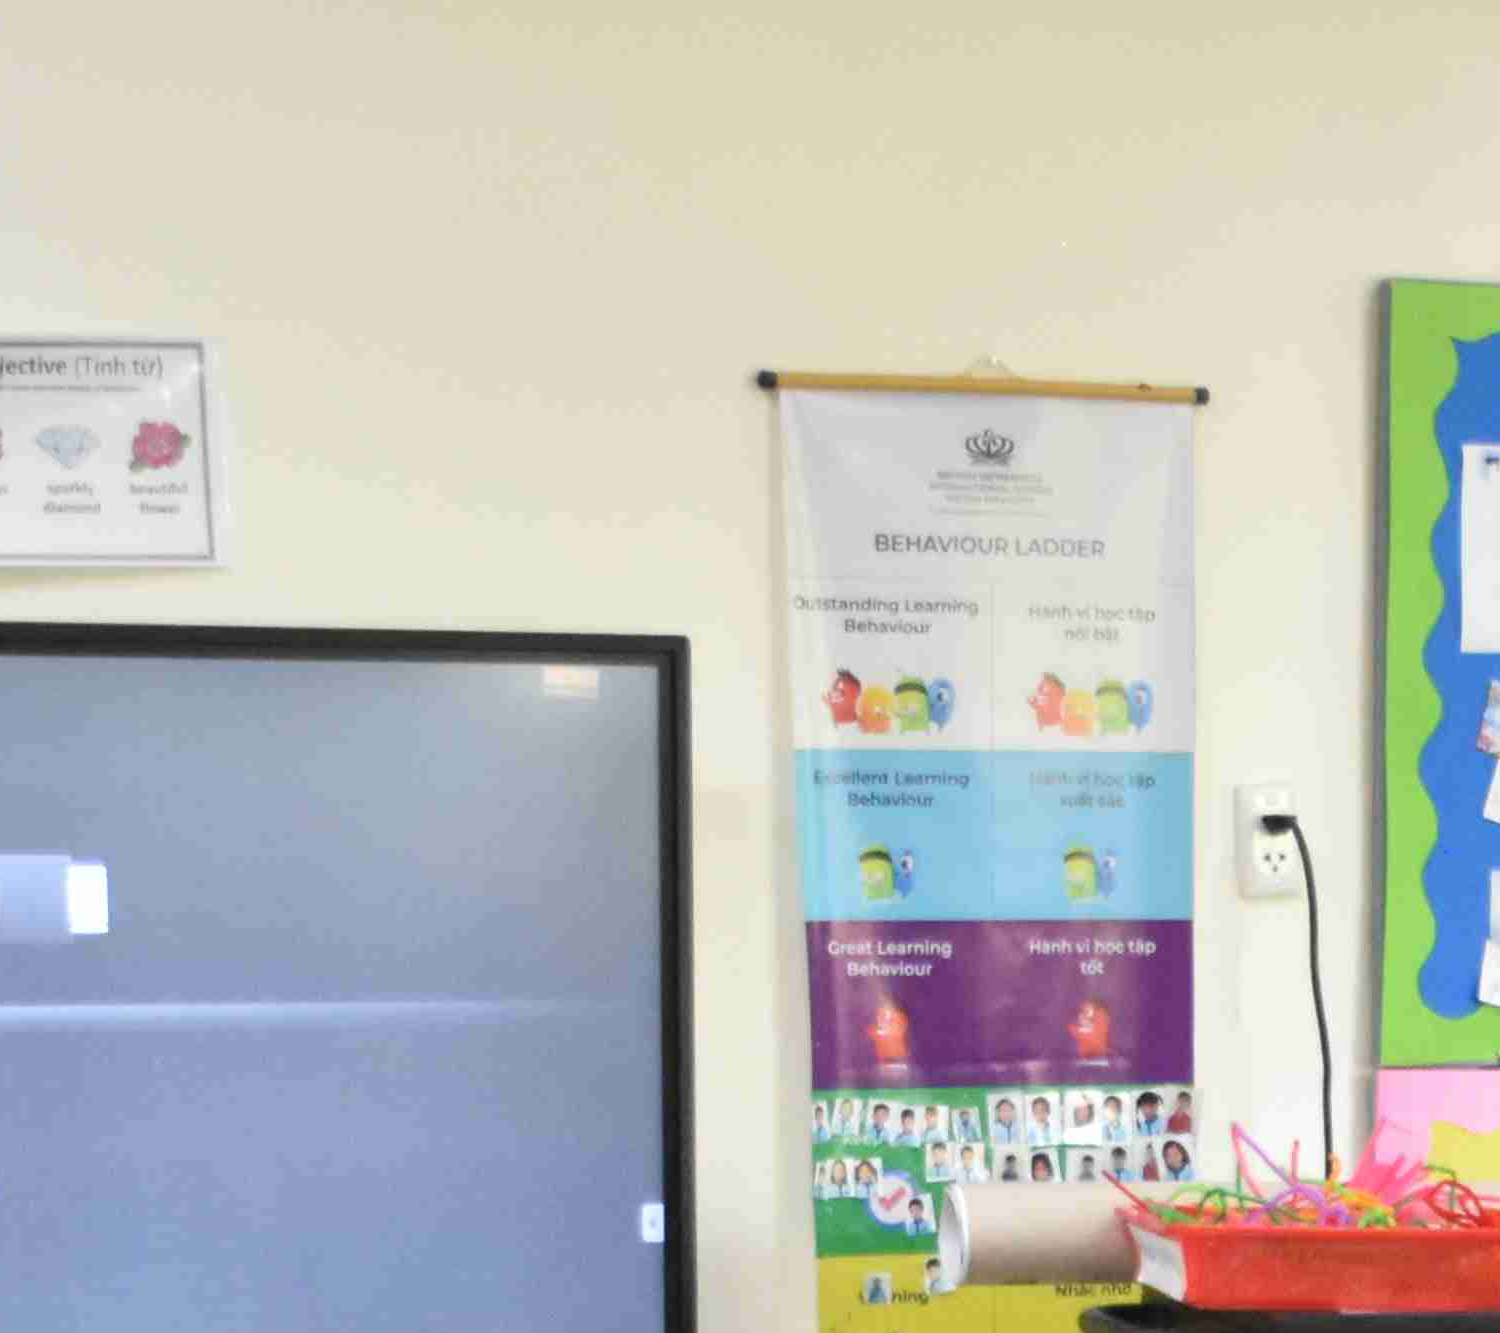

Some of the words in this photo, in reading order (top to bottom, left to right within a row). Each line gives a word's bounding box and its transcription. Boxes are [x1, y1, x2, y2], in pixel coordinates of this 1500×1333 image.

[874, 533, 1009, 556] BEHAVIOUR
[1014, 538, 1106, 559] LADDER
[793, 594, 900, 614] Outstanding
[904, 598, 980, 618] Learning
[843, 618, 932, 635] Behaviour
[894, 771, 970, 790] Learning
[847, 791, 935, 808] Behaviour
[828, 940, 873, 955] Great
[877, 940, 953, 958] Learning
[847, 960, 933, 977] Behaviour
